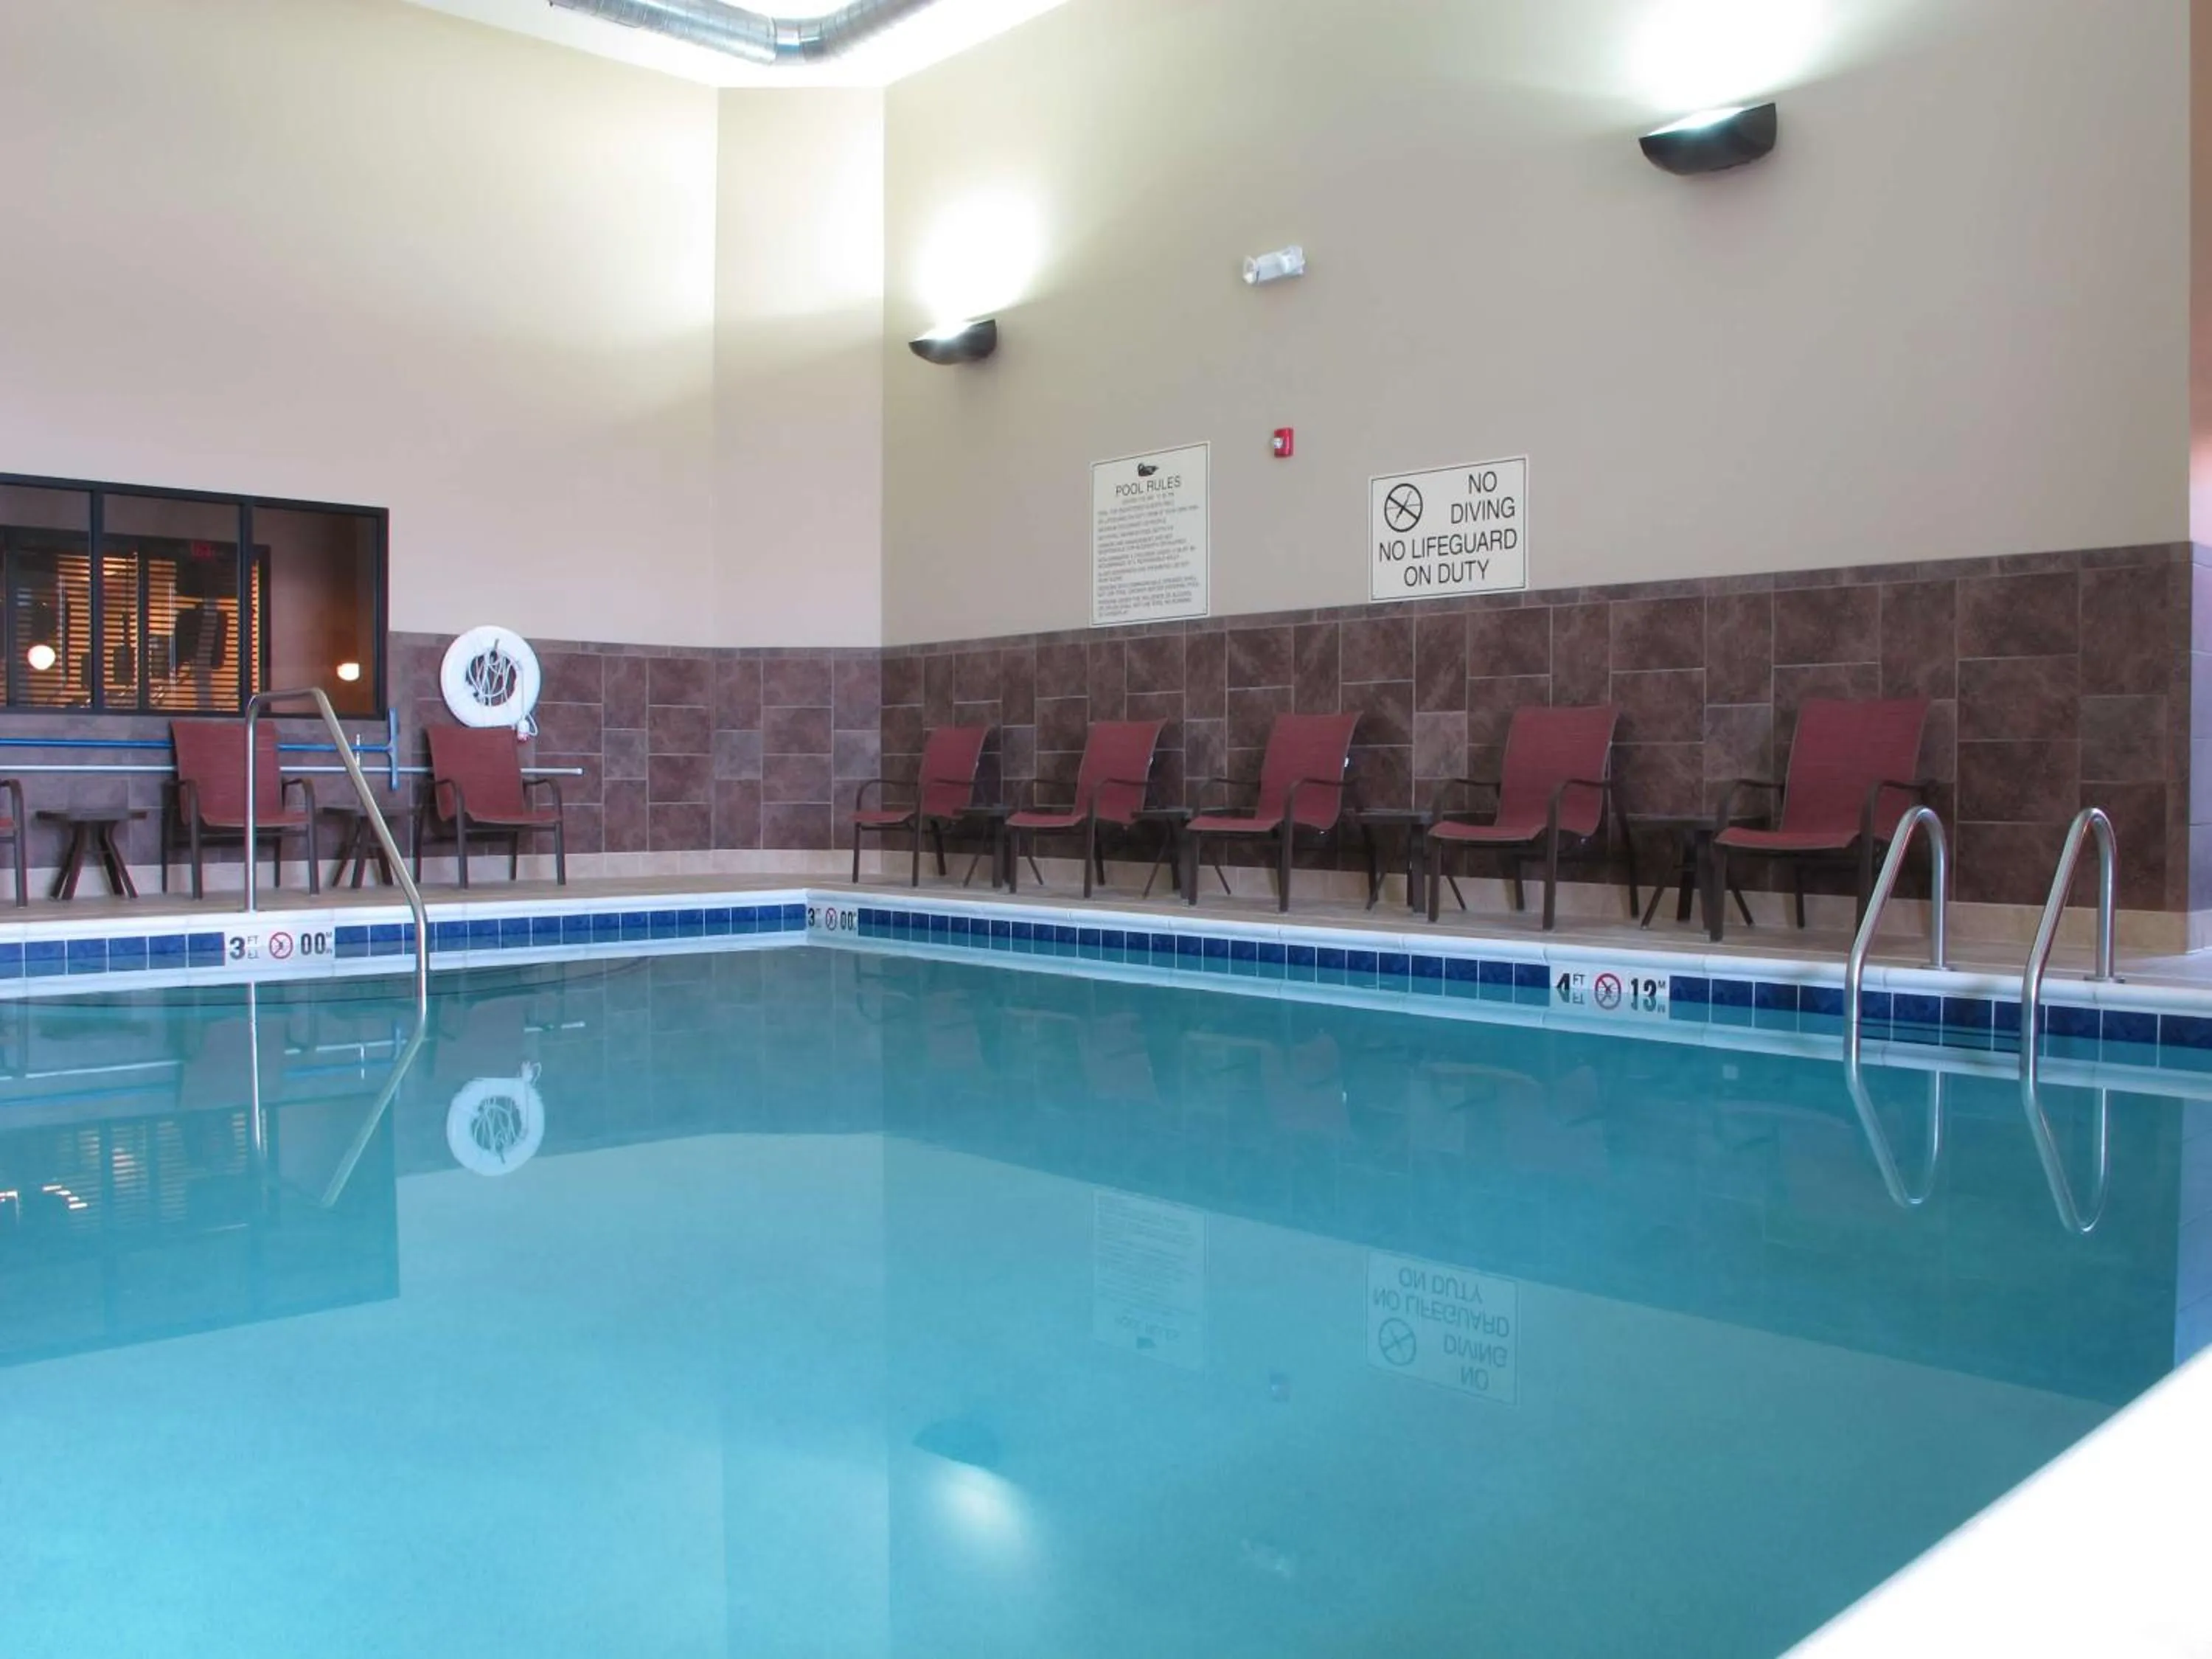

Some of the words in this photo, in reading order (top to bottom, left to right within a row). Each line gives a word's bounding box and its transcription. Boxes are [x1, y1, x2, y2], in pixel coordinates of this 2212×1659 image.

[1115, 482, 1144, 497] POOL
[1147, 475, 1182, 492] RULES
[1468, 471, 1498, 495] NO
[1450, 496, 1516, 524] DIVING
[1379, 540, 1406, 562] NO
[1411, 528, 1518, 559] LIFEGUARD
[1403, 566, 1432, 587] ON
[1438, 559, 1489, 583] DUTY
[229, 936, 246, 960] 3
[1572, 974, 1587, 986] FT
